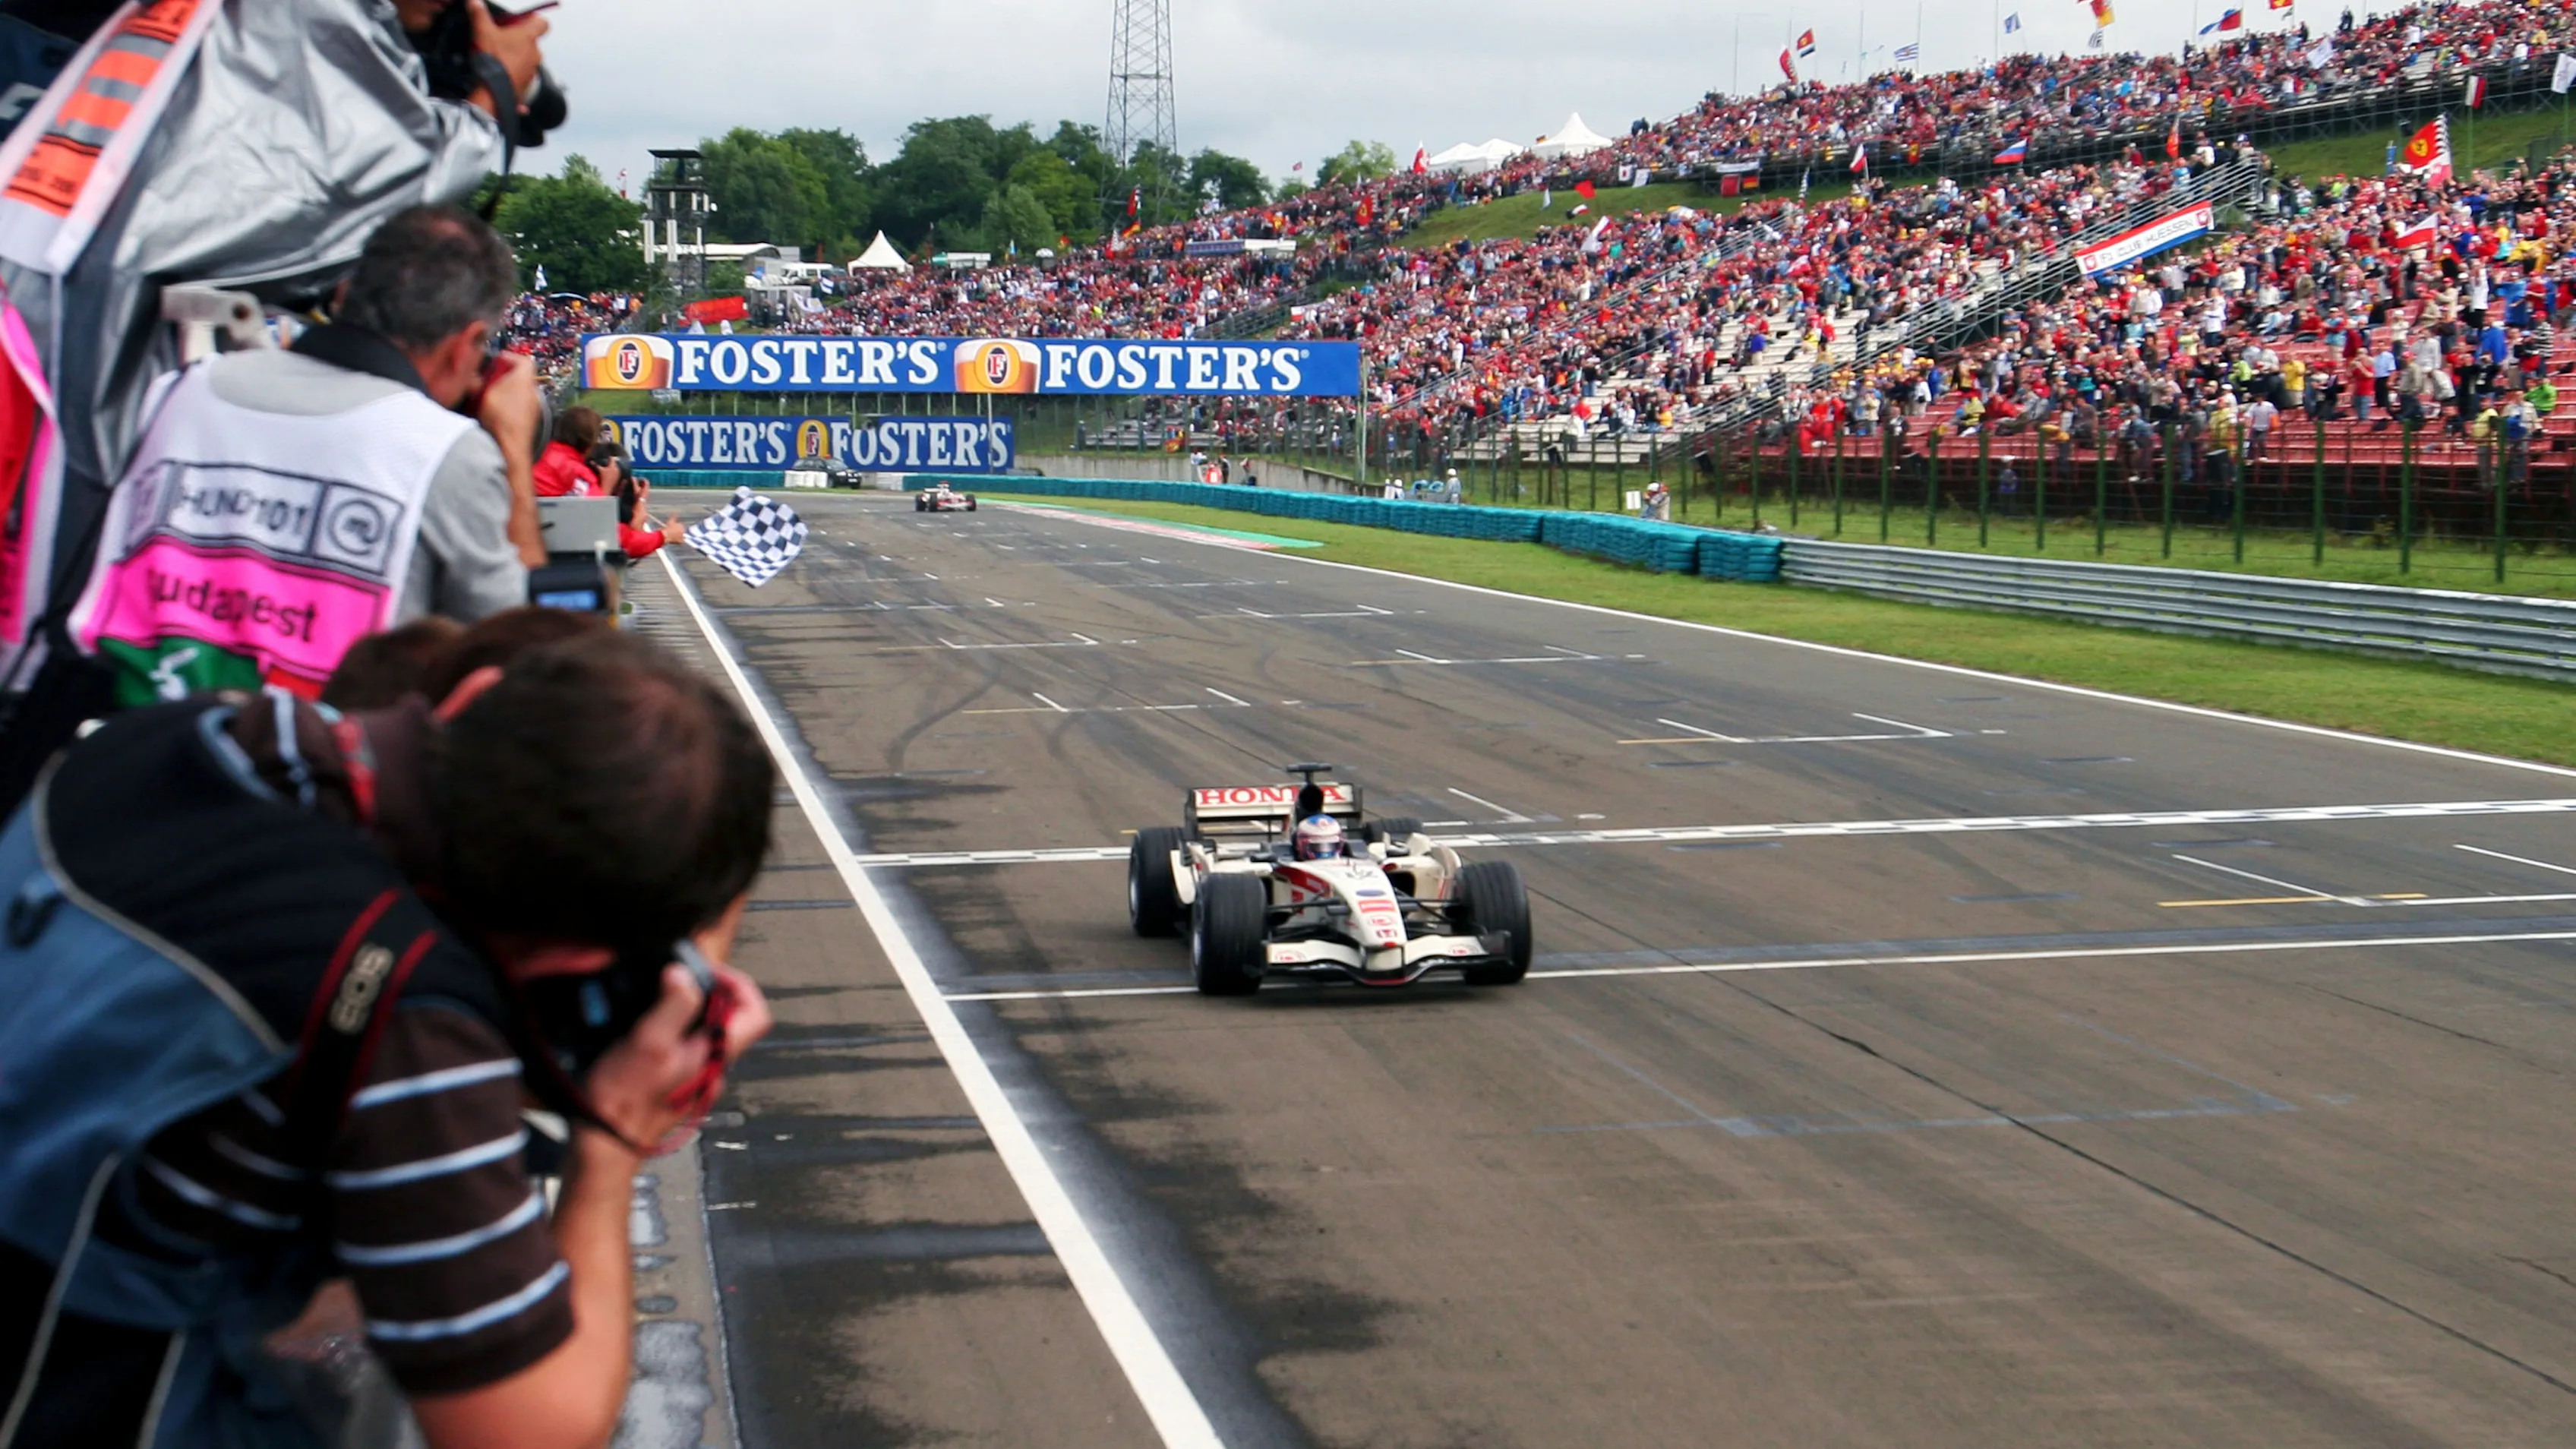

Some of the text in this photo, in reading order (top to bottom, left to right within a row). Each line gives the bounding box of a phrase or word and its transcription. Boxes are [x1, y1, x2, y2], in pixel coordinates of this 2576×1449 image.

[677, 339, 939, 385] FOSTER'S
[1045, 344, 1302, 391] FOSTER'S
[623, 420, 787, 464] FOSTER'S
[830, 421, 1008, 468] FOSTER'S
